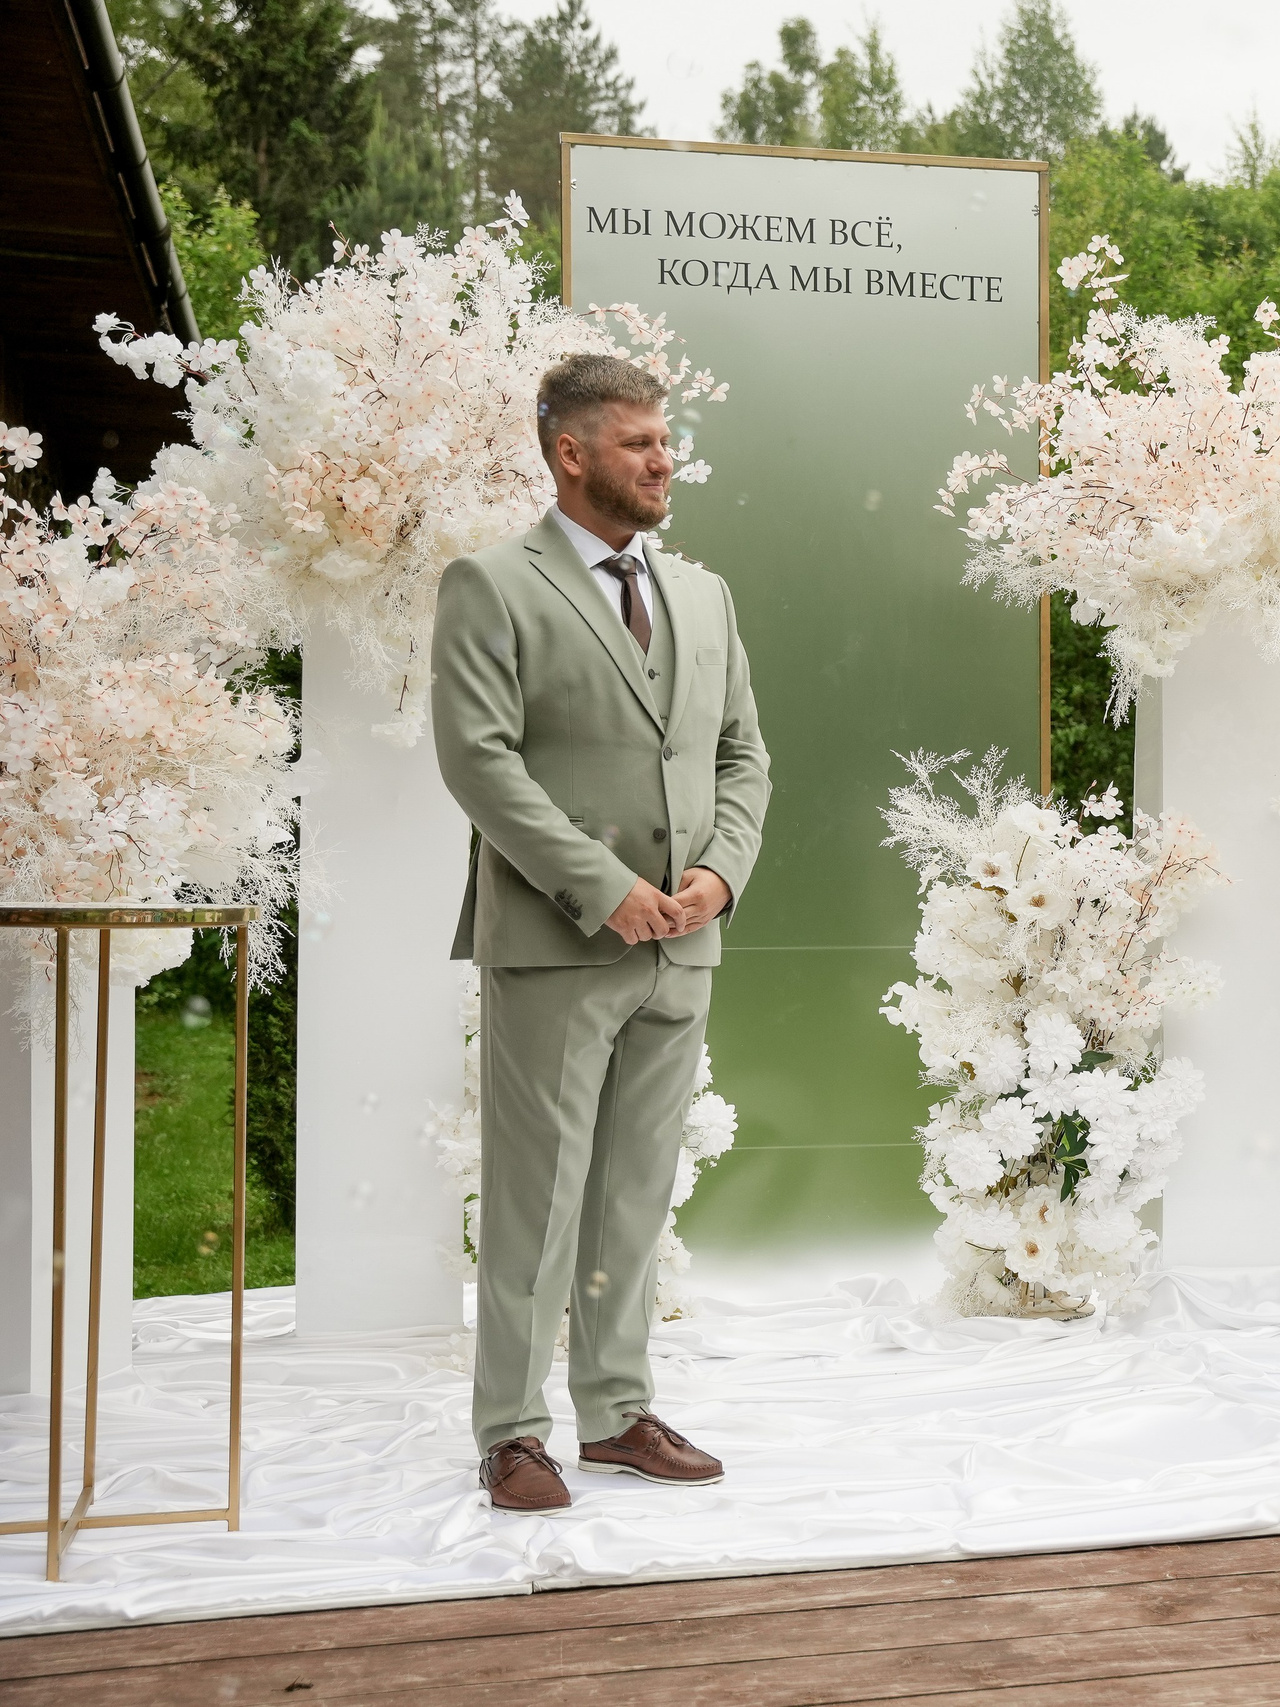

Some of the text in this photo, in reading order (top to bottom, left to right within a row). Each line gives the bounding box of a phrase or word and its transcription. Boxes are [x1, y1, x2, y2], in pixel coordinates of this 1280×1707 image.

[586, 205, 904, 254] МЫ МОЖЕМ ВСЁ,
[657, 257, 1004, 303] КОГДА МЫ ВМЕСТЕ
